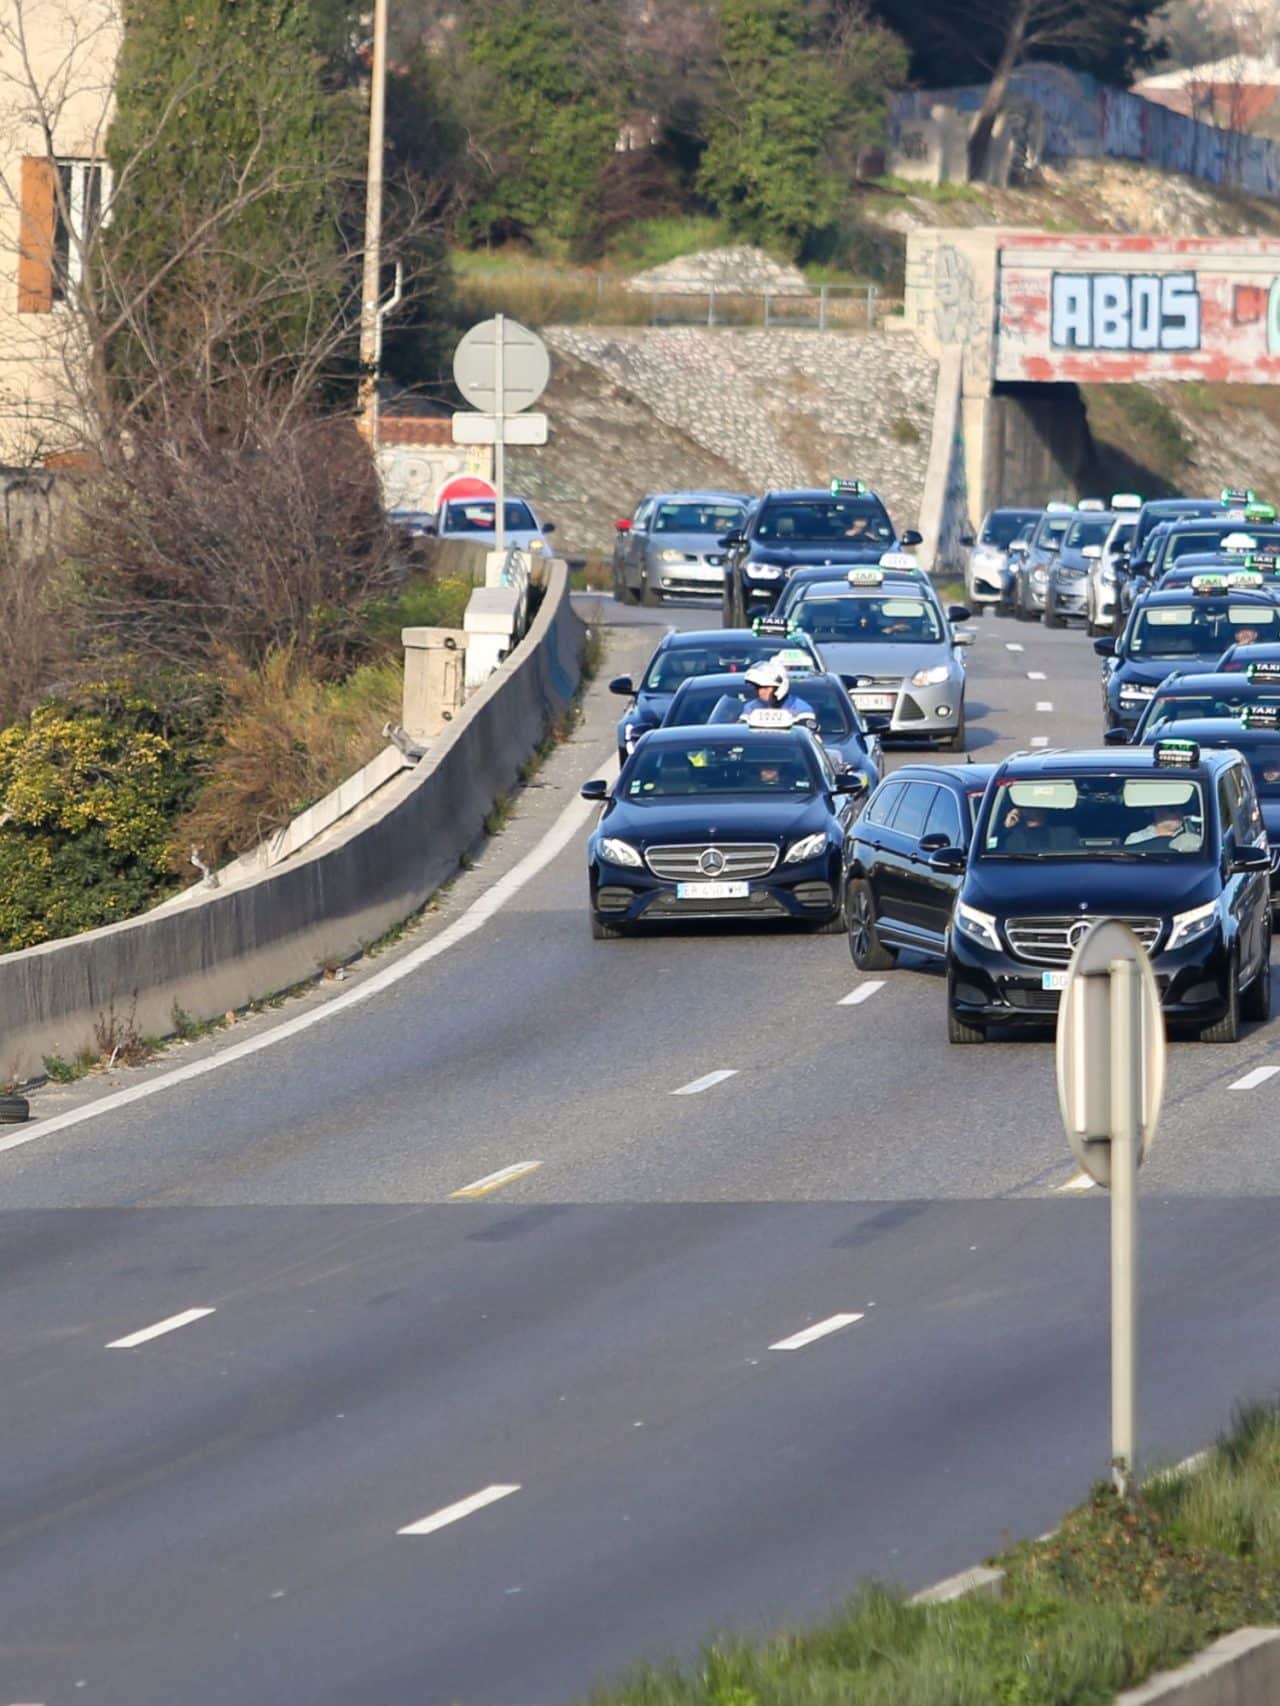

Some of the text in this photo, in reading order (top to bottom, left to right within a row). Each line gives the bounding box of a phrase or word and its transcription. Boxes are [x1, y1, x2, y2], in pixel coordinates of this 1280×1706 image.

[1051, 271, 1200, 351] ABOS
[761, 617, 785, 625] TAXI
[1255, 663, 1280, 671] TAXI
[1249, 706, 1277, 715] TAXI
